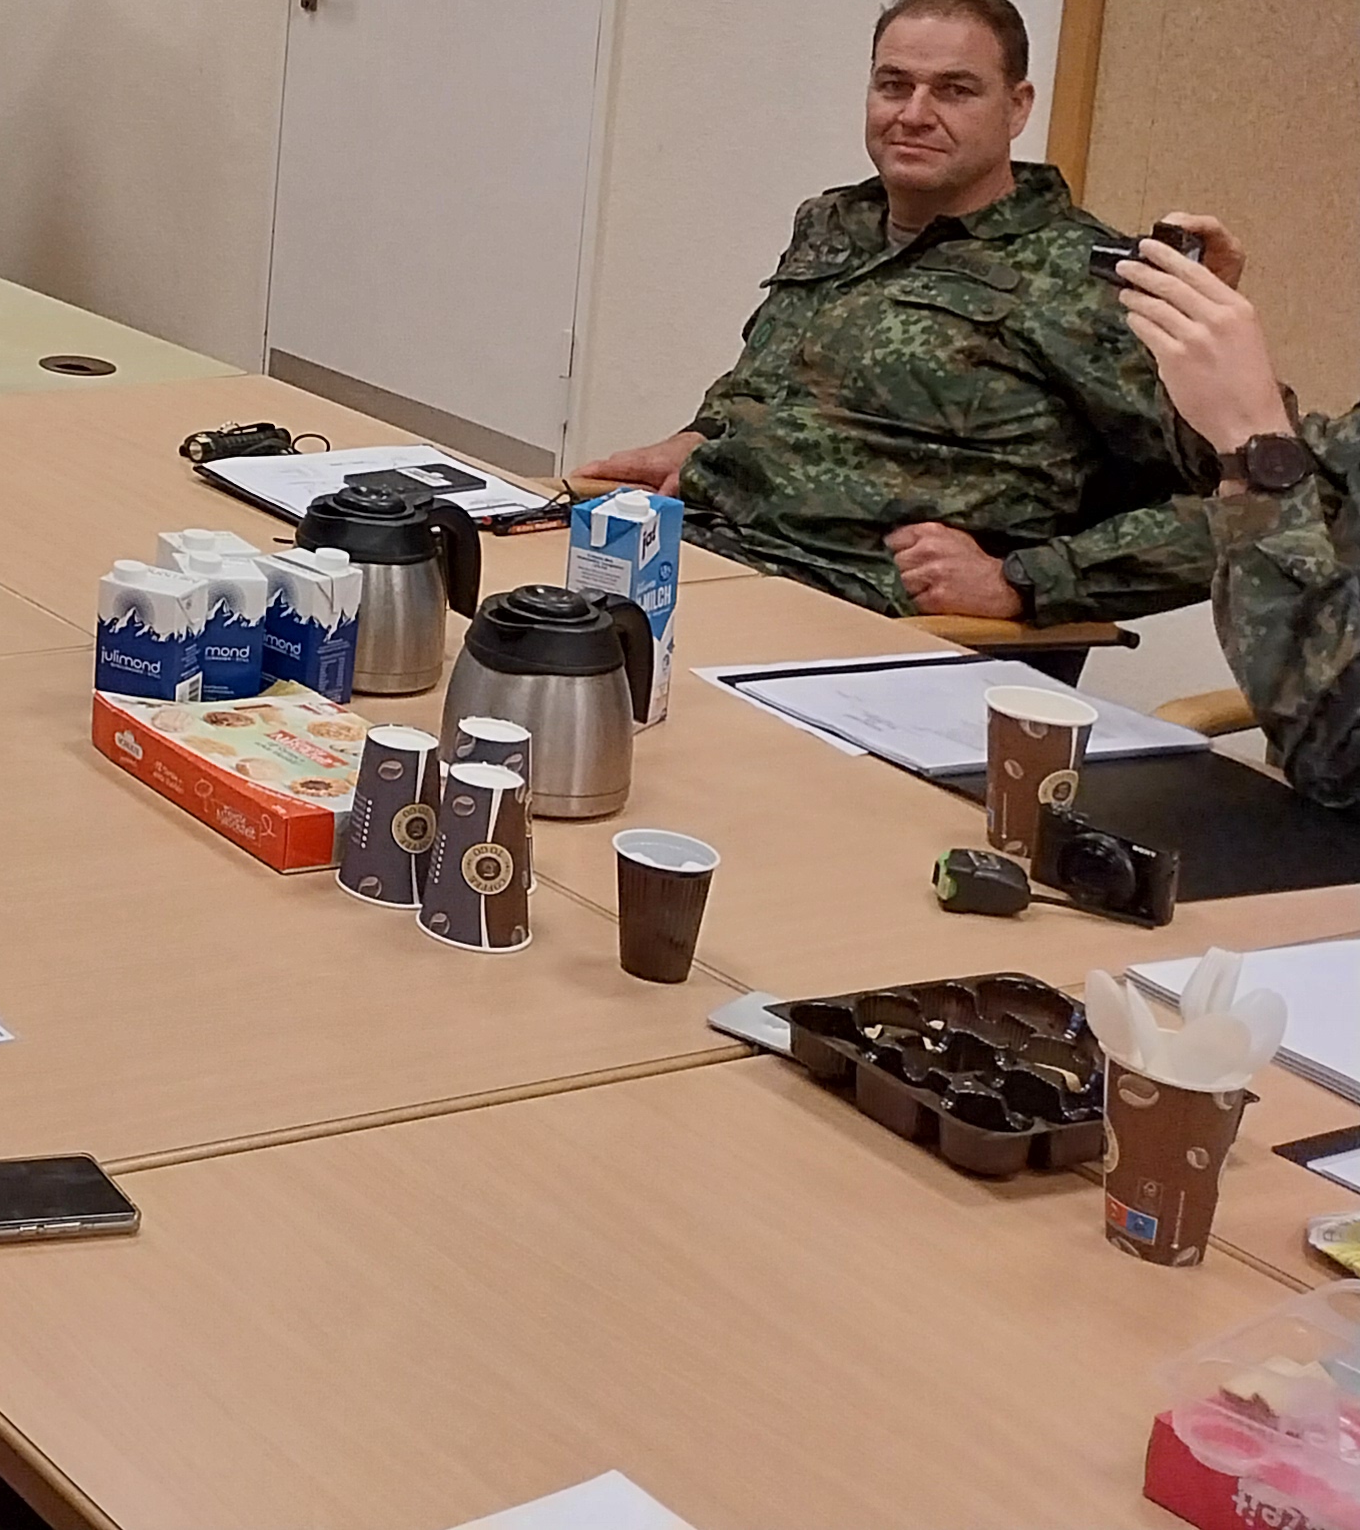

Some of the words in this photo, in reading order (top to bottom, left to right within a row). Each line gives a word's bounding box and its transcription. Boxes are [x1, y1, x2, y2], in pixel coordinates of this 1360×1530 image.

[101, 645, 161, 674] julimond
[472, 846, 489, 857] GO
[490, 846, 504, 857] TO
